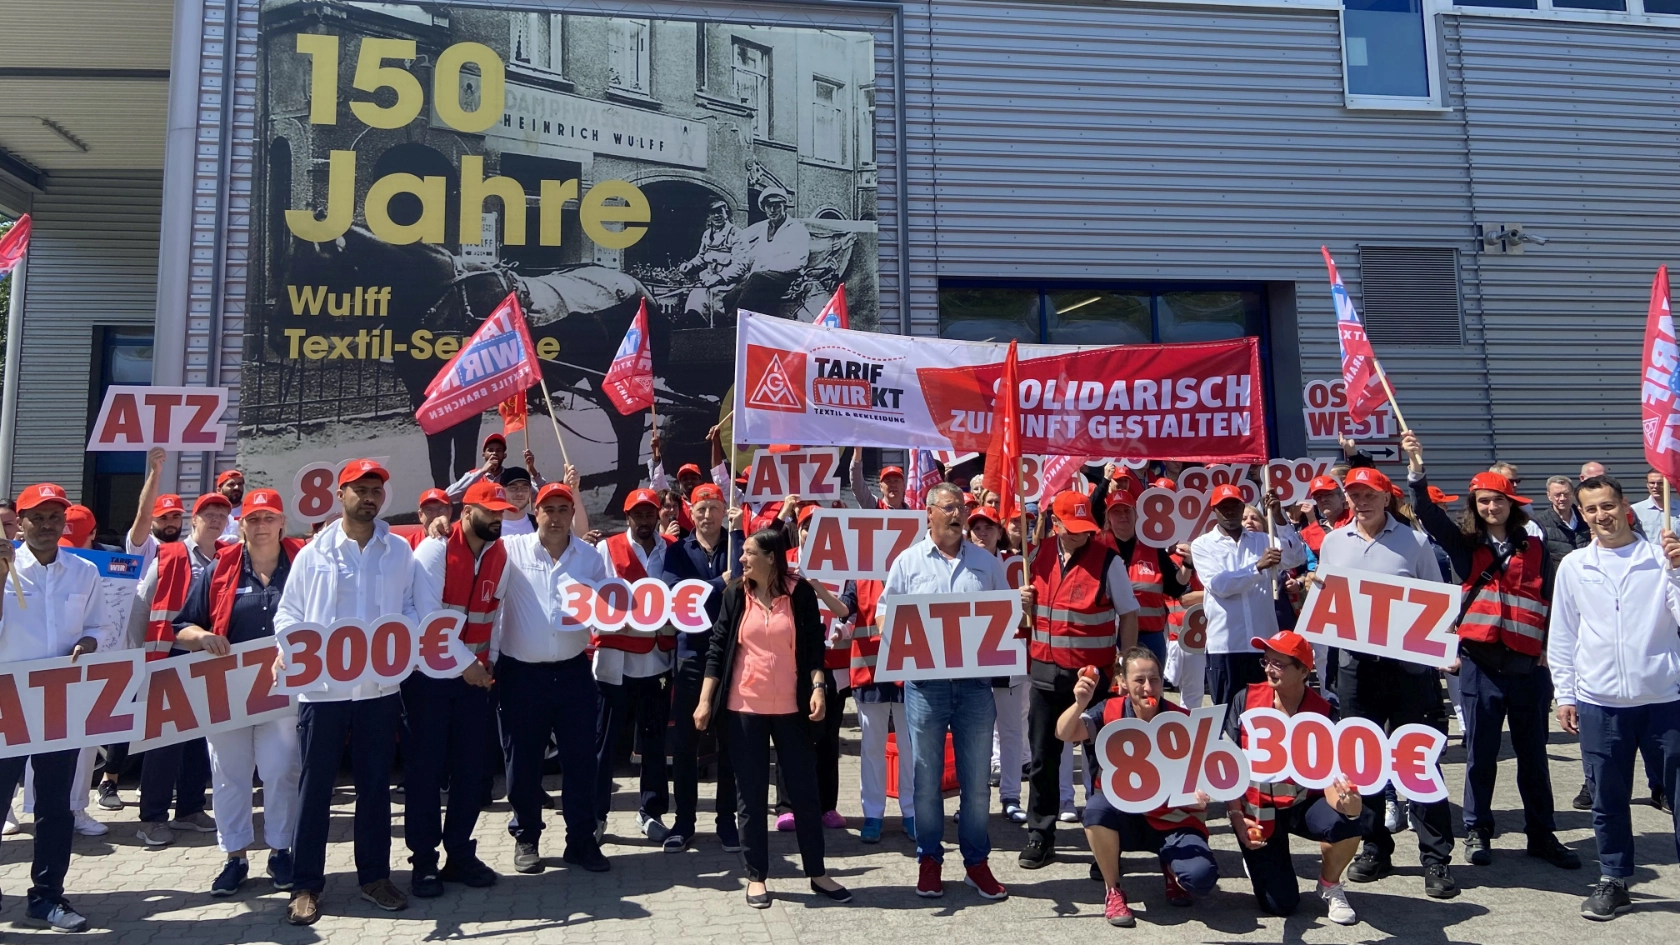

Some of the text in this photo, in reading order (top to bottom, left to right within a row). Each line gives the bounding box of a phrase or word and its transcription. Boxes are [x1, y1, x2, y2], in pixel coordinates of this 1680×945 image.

[297, 33, 507, 133] 150
[503, 113, 665, 152] HEINRICH WULFF
[284, 149, 652, 249] Jahre
[287, 285, 392, 317] Wulff
[284, 328, 561, 360] Textil-See
[814, 357, 884, 384] TARIF
[98, 393, 220, 444] ATZ
[813, 408, 843, 417] TEXTIL
[853, 412, 906, 424] BEKLEIDUNG
[1308, 383, 1348, 408] OS
[950, 409, 1081, 439] ZUNFT
[1088, 411, 1252, 439] GESTALTEN
[1308, 410, 1389, 437] WEST
[752, 453, 834, 496] ATZ
[1142, 493, 1219, 542] 8%
[806, 516, 919, 571] ATZ
[561, 583, 706, 627] 300€
[1305, 574, 1450, 658] ATZ
[285, 616, 459, 688] 300€
[885, 599, 1017, 671] ATZ
[144, 645, 290, 740] ATZ
[1105, 717, 1242, 802] 8%
[1250, 714, 1439, 795] 300€
